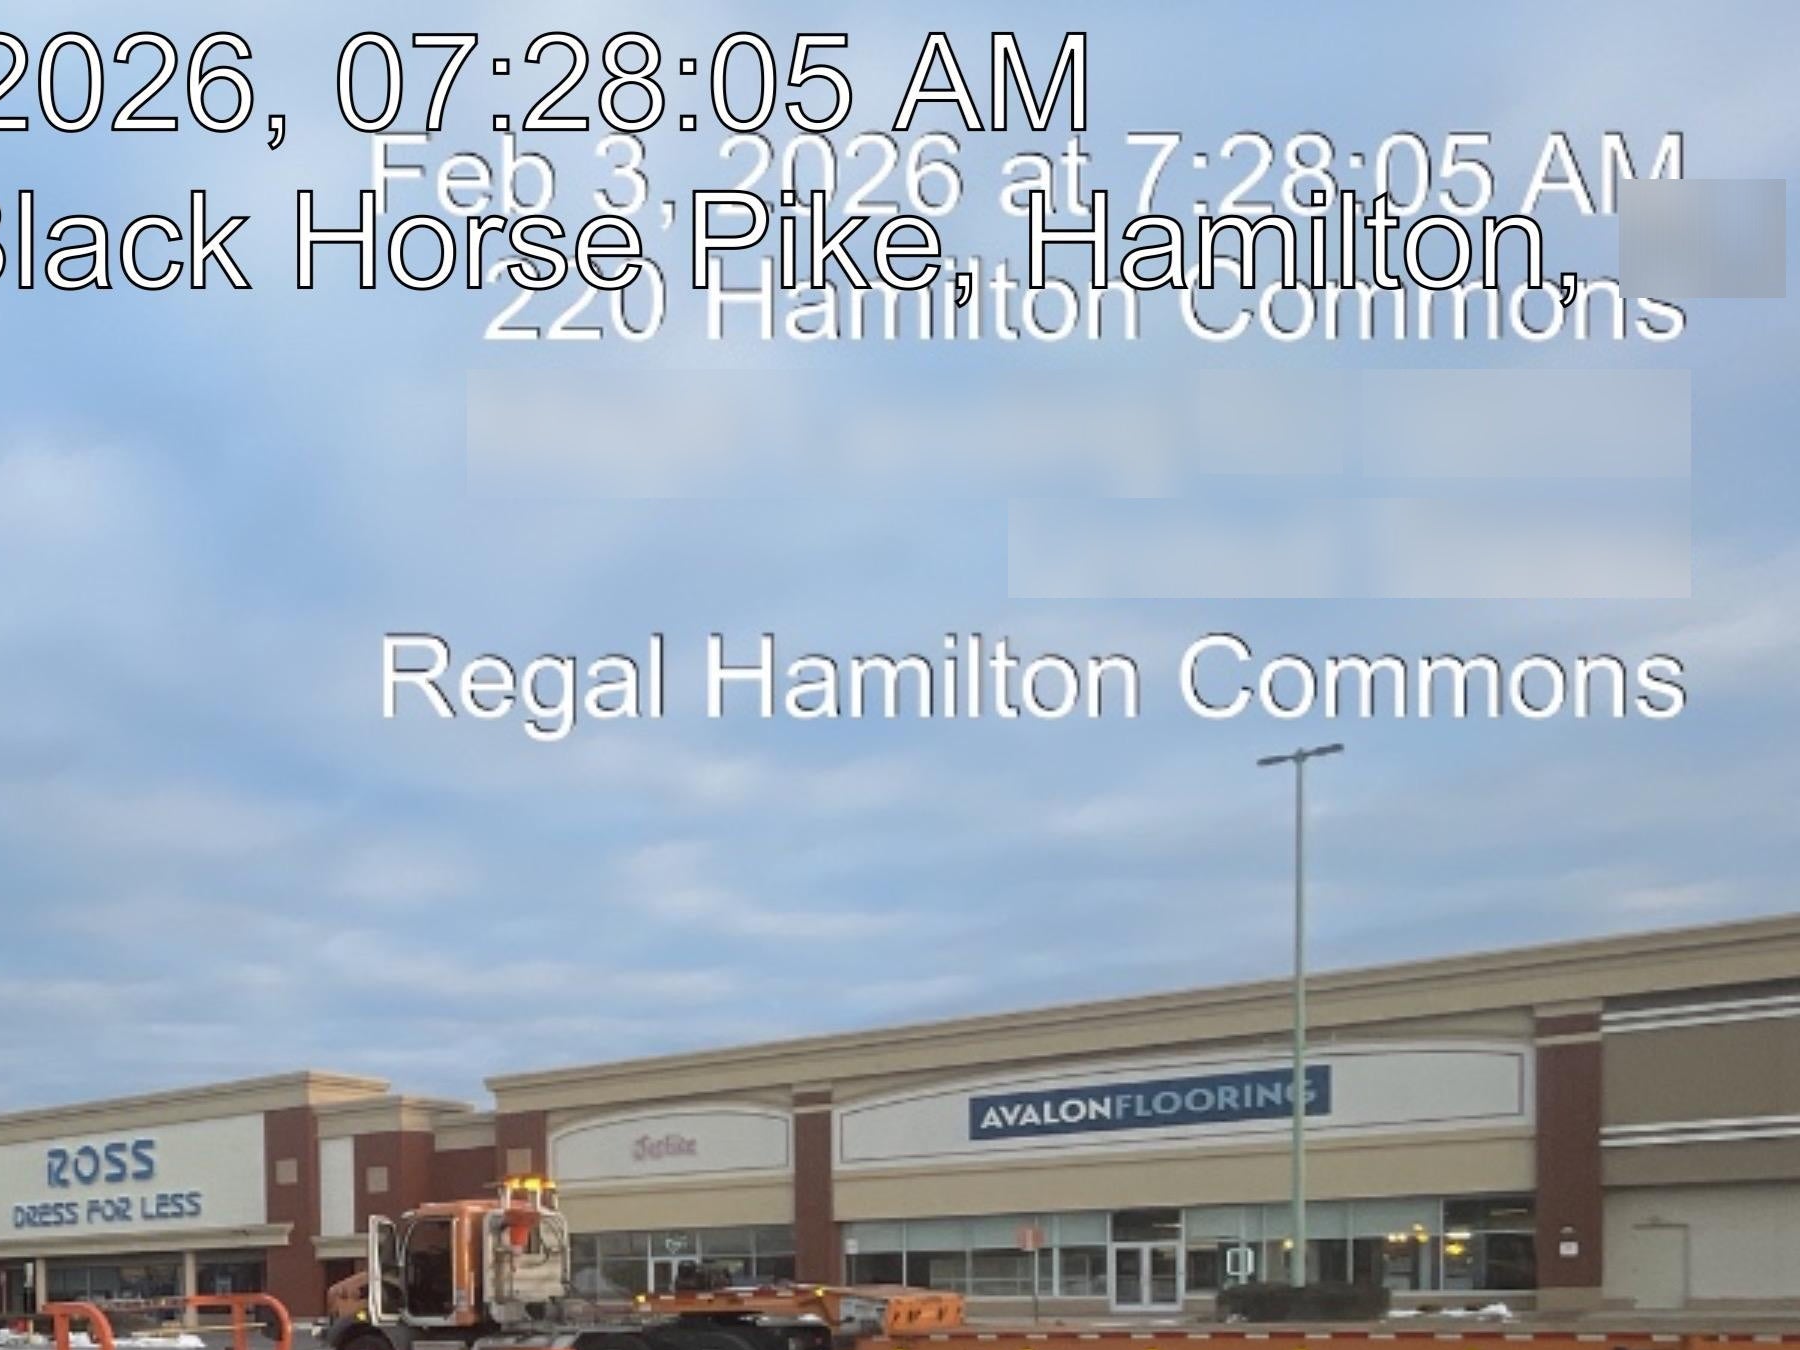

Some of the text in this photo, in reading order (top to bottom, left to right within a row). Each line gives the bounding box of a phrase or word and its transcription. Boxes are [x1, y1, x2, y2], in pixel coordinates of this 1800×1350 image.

[47, 1139, 156, 1188] ROSS
[13, 1191, 203, 1229] DRESS FOR LESS
